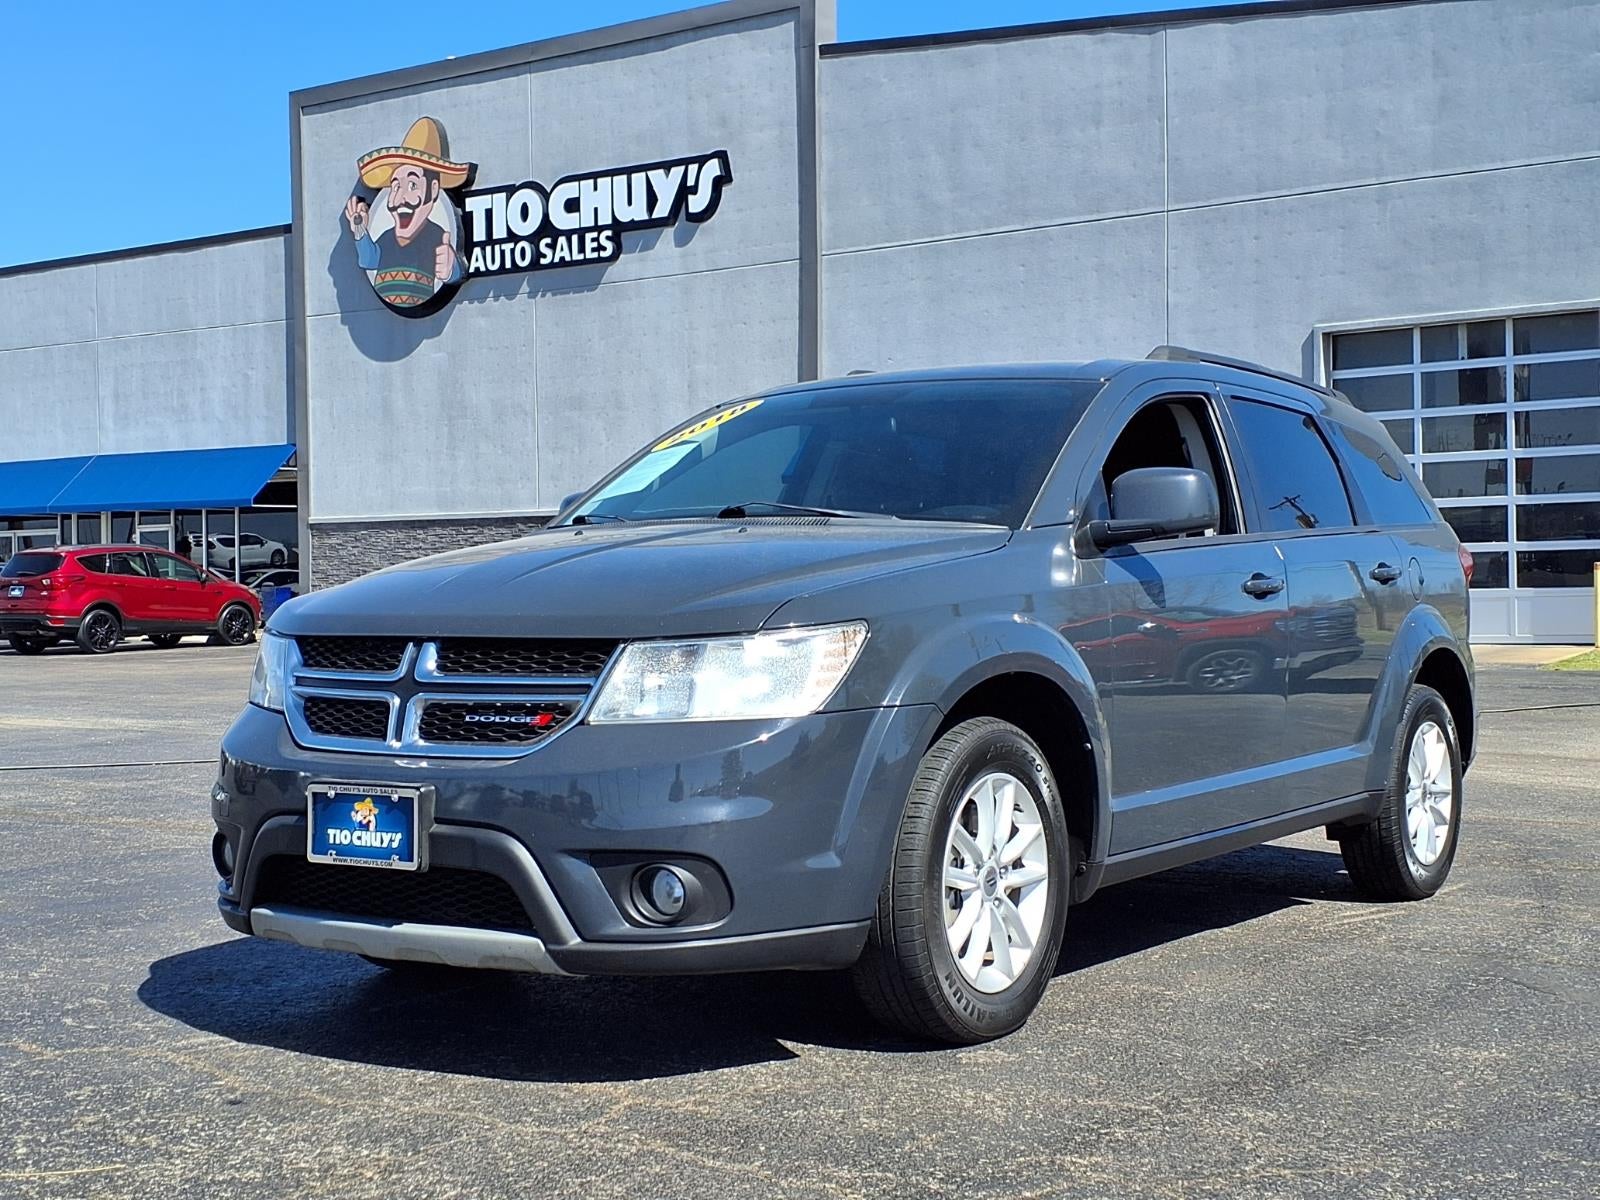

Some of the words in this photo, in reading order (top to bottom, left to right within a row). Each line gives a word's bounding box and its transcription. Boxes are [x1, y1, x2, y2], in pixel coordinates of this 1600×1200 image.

[465, 189, 544, 242] TIO
[548, 158, 721, 230] CHUY'S
[469, 240, 532, 273] AUTO
[540, 230, 614, 265] SALES
[465, 714, 541, 723] DODGE
[362, 787, 379, 795] AUTO
[328, 828, 351, 845] TIO
[352, 830, 403, 849] CHUY'S
